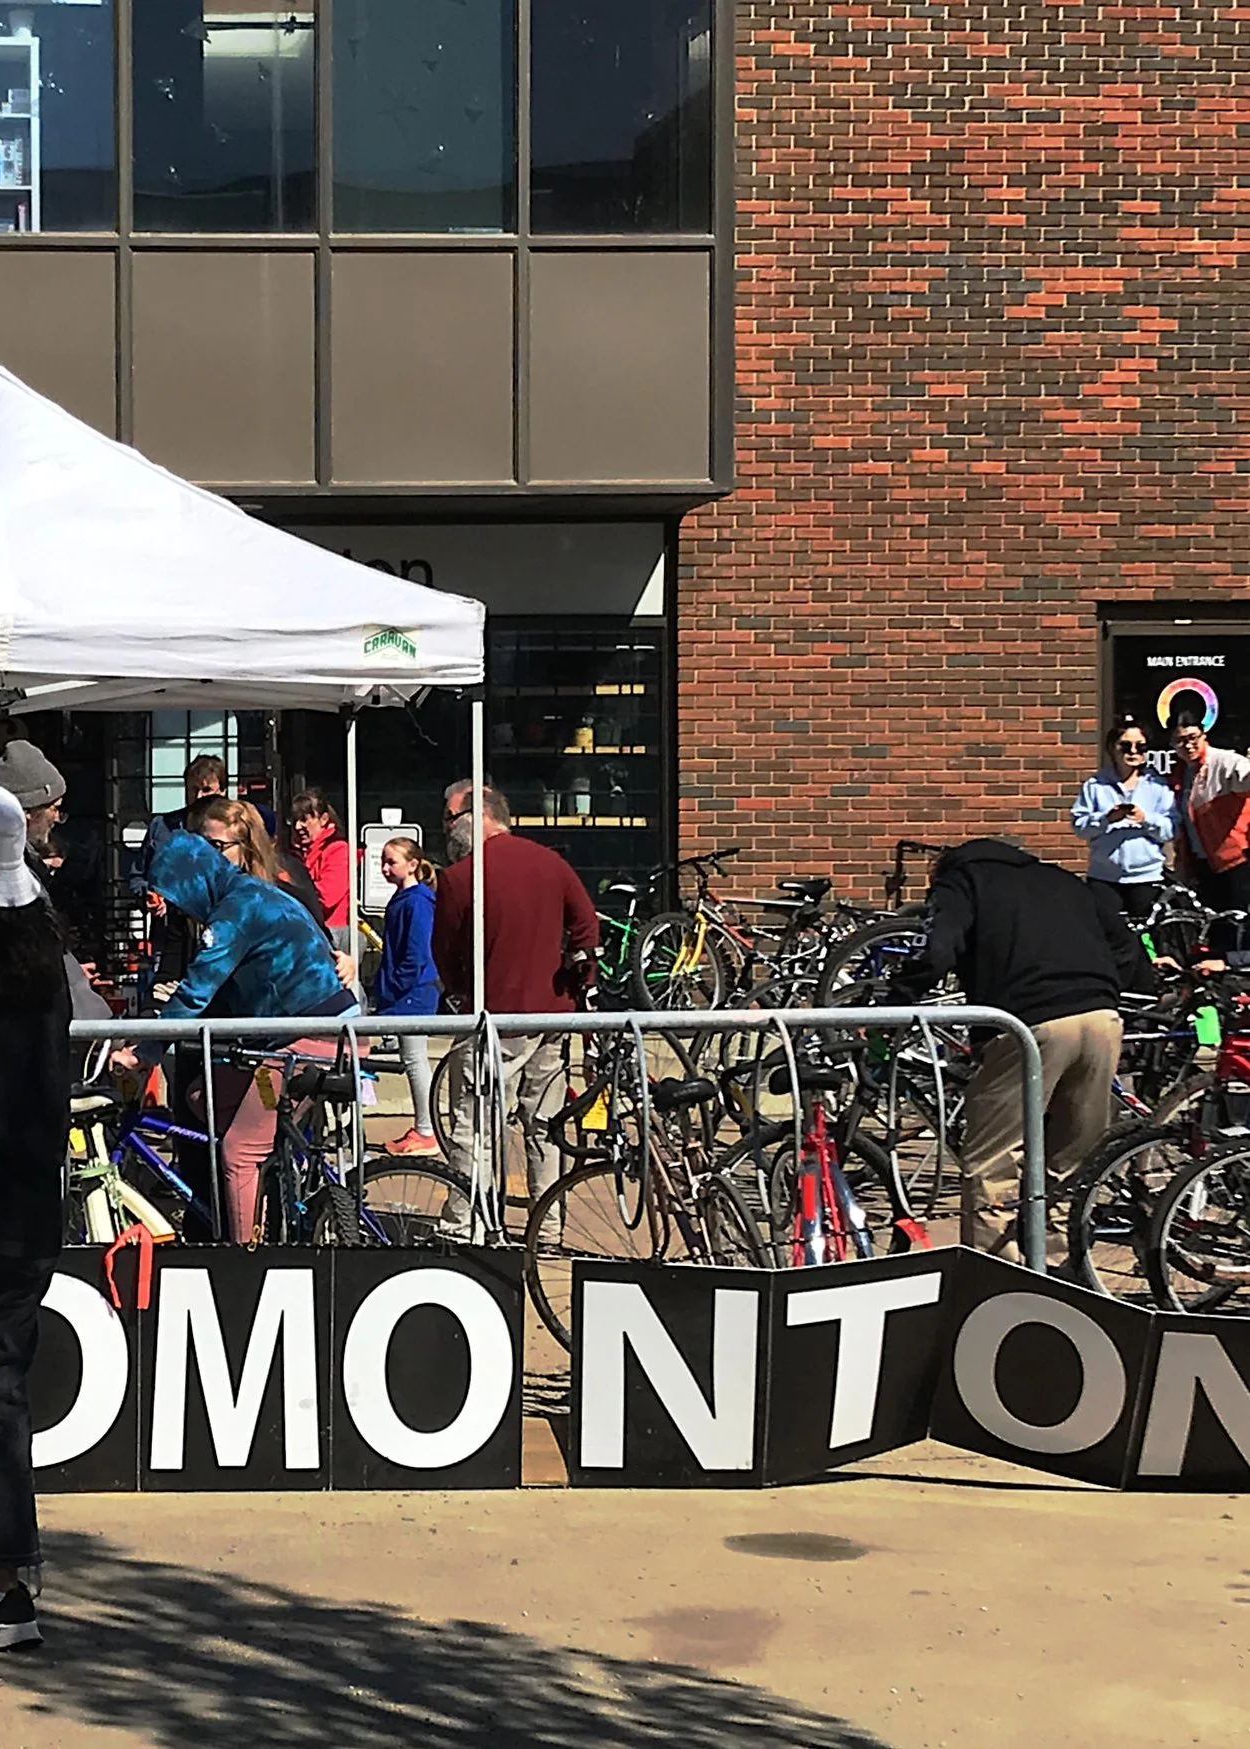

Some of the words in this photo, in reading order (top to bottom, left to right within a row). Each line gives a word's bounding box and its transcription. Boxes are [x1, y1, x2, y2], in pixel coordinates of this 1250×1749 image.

[363, 630, 417, 658] CARAVAN
[1147, 656, 1173, 667] MAIN
[1175, 655, 1226, 667] ENTRANCE
